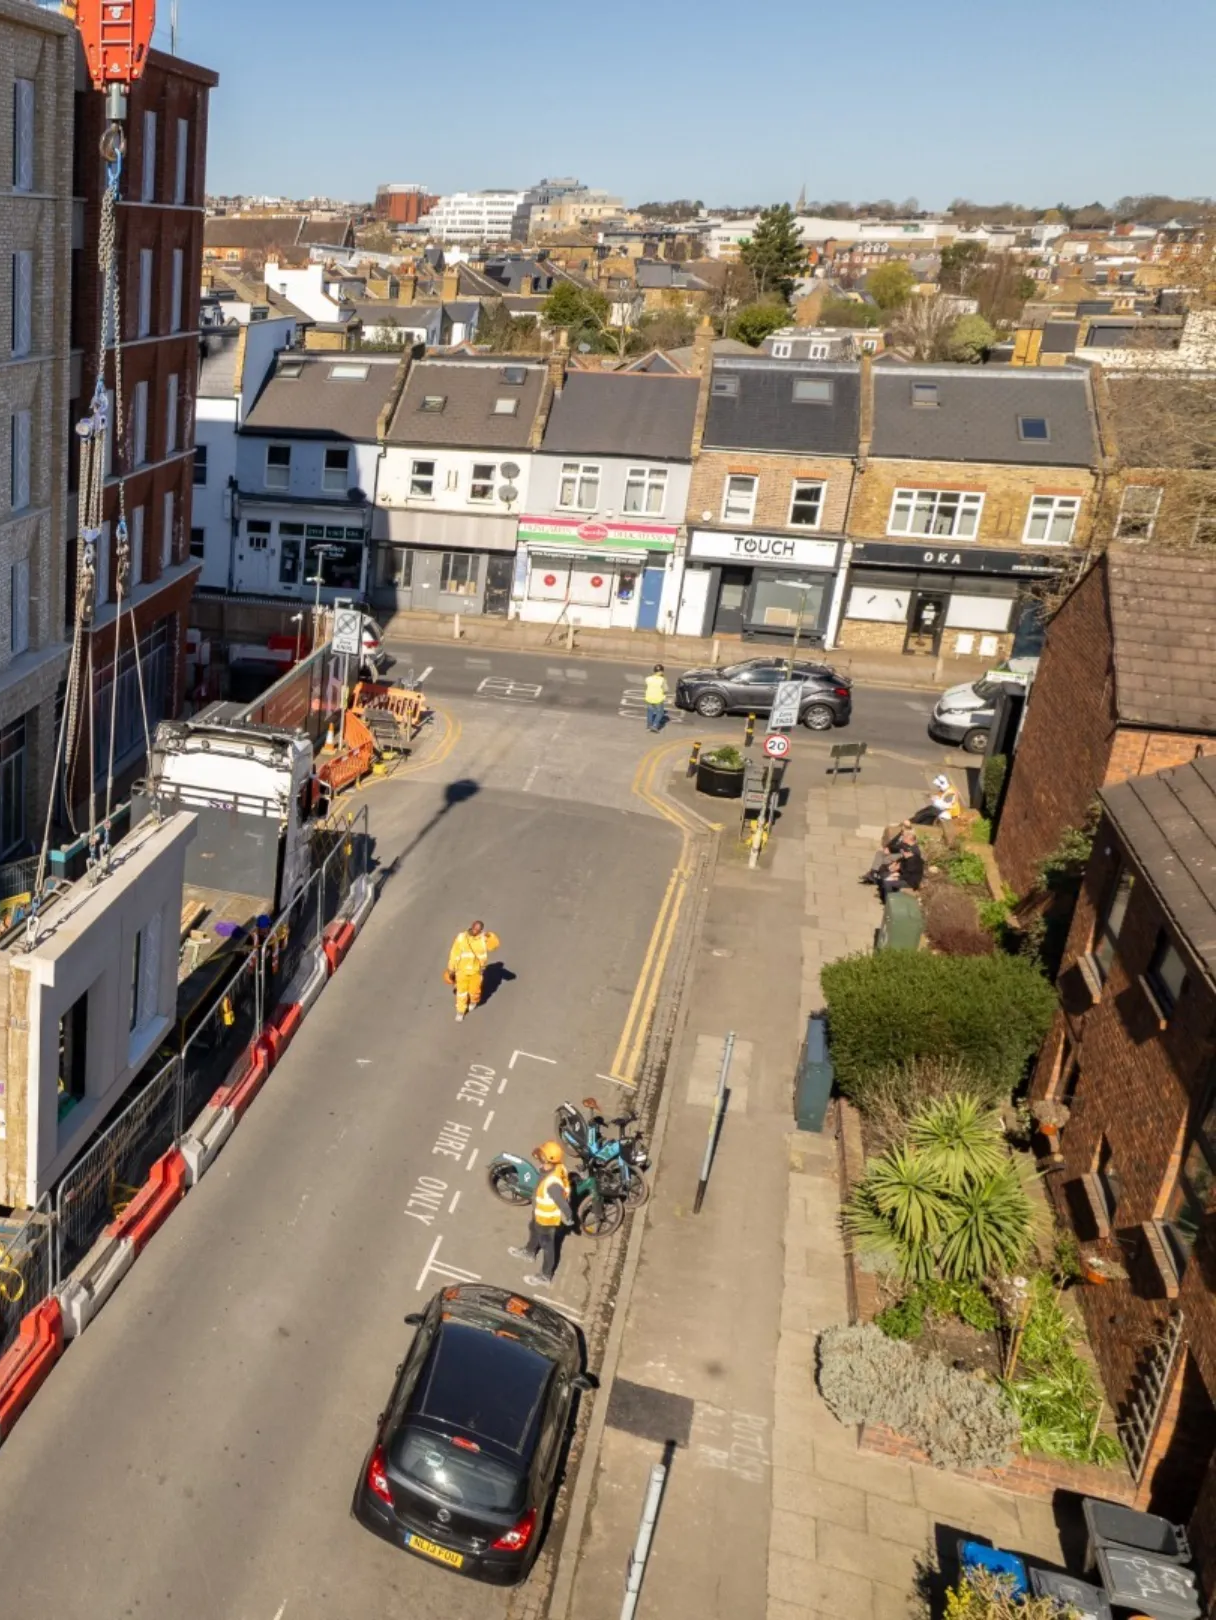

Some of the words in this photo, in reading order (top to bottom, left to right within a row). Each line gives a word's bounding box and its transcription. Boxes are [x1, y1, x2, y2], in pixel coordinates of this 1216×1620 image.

[734, 537, 795, 556] TOUCH
[923, 552, 962, 565] OKA
[768, 740, 786, 751] 20
[456, 1064, 496, 1107] CYCLE
[432, 1120, 473, 1161] HIRE
[404, 1176, 448, 1226] ONLY
